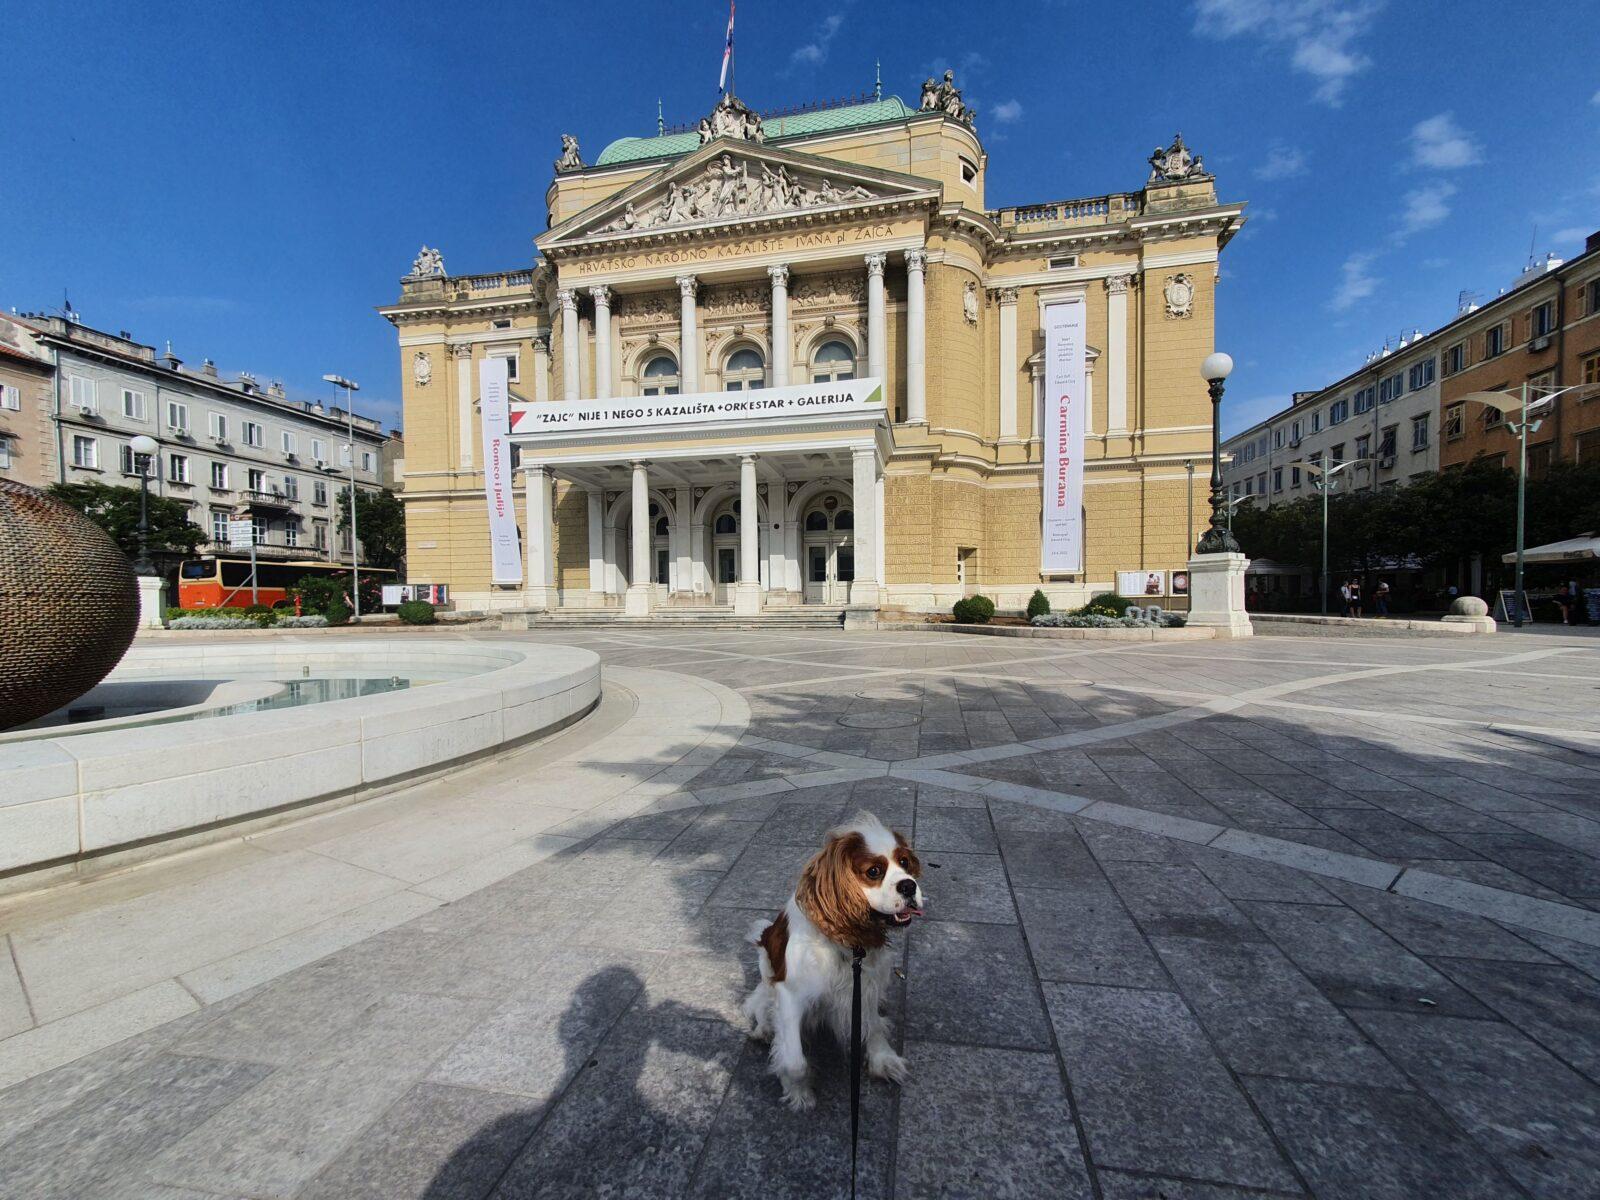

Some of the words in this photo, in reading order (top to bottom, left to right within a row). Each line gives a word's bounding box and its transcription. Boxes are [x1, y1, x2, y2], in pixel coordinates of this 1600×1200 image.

[579, 258, 636, 274] HRVATSKO
[645, 249, 708, 267] NARODNO
[717, 239, 784, 258] KAZALIŠTE
[796, 234, 832, 248] IVANA
[854, 226, 893, 240] ZAJCA
[578, 411, 601, 421] NIJE
[603, 410, 608, 420] 1
[612, 408, 644, 419] NEGO
[656, 401, 715, 417] KAZALIŠTA
[797, 393, 854, 406] GALERIJA
[1059, 395, 1071, 454] Carmina
[492, 439, 500, 480] Romeo
[1057, 457, 1070, 508] Burana
